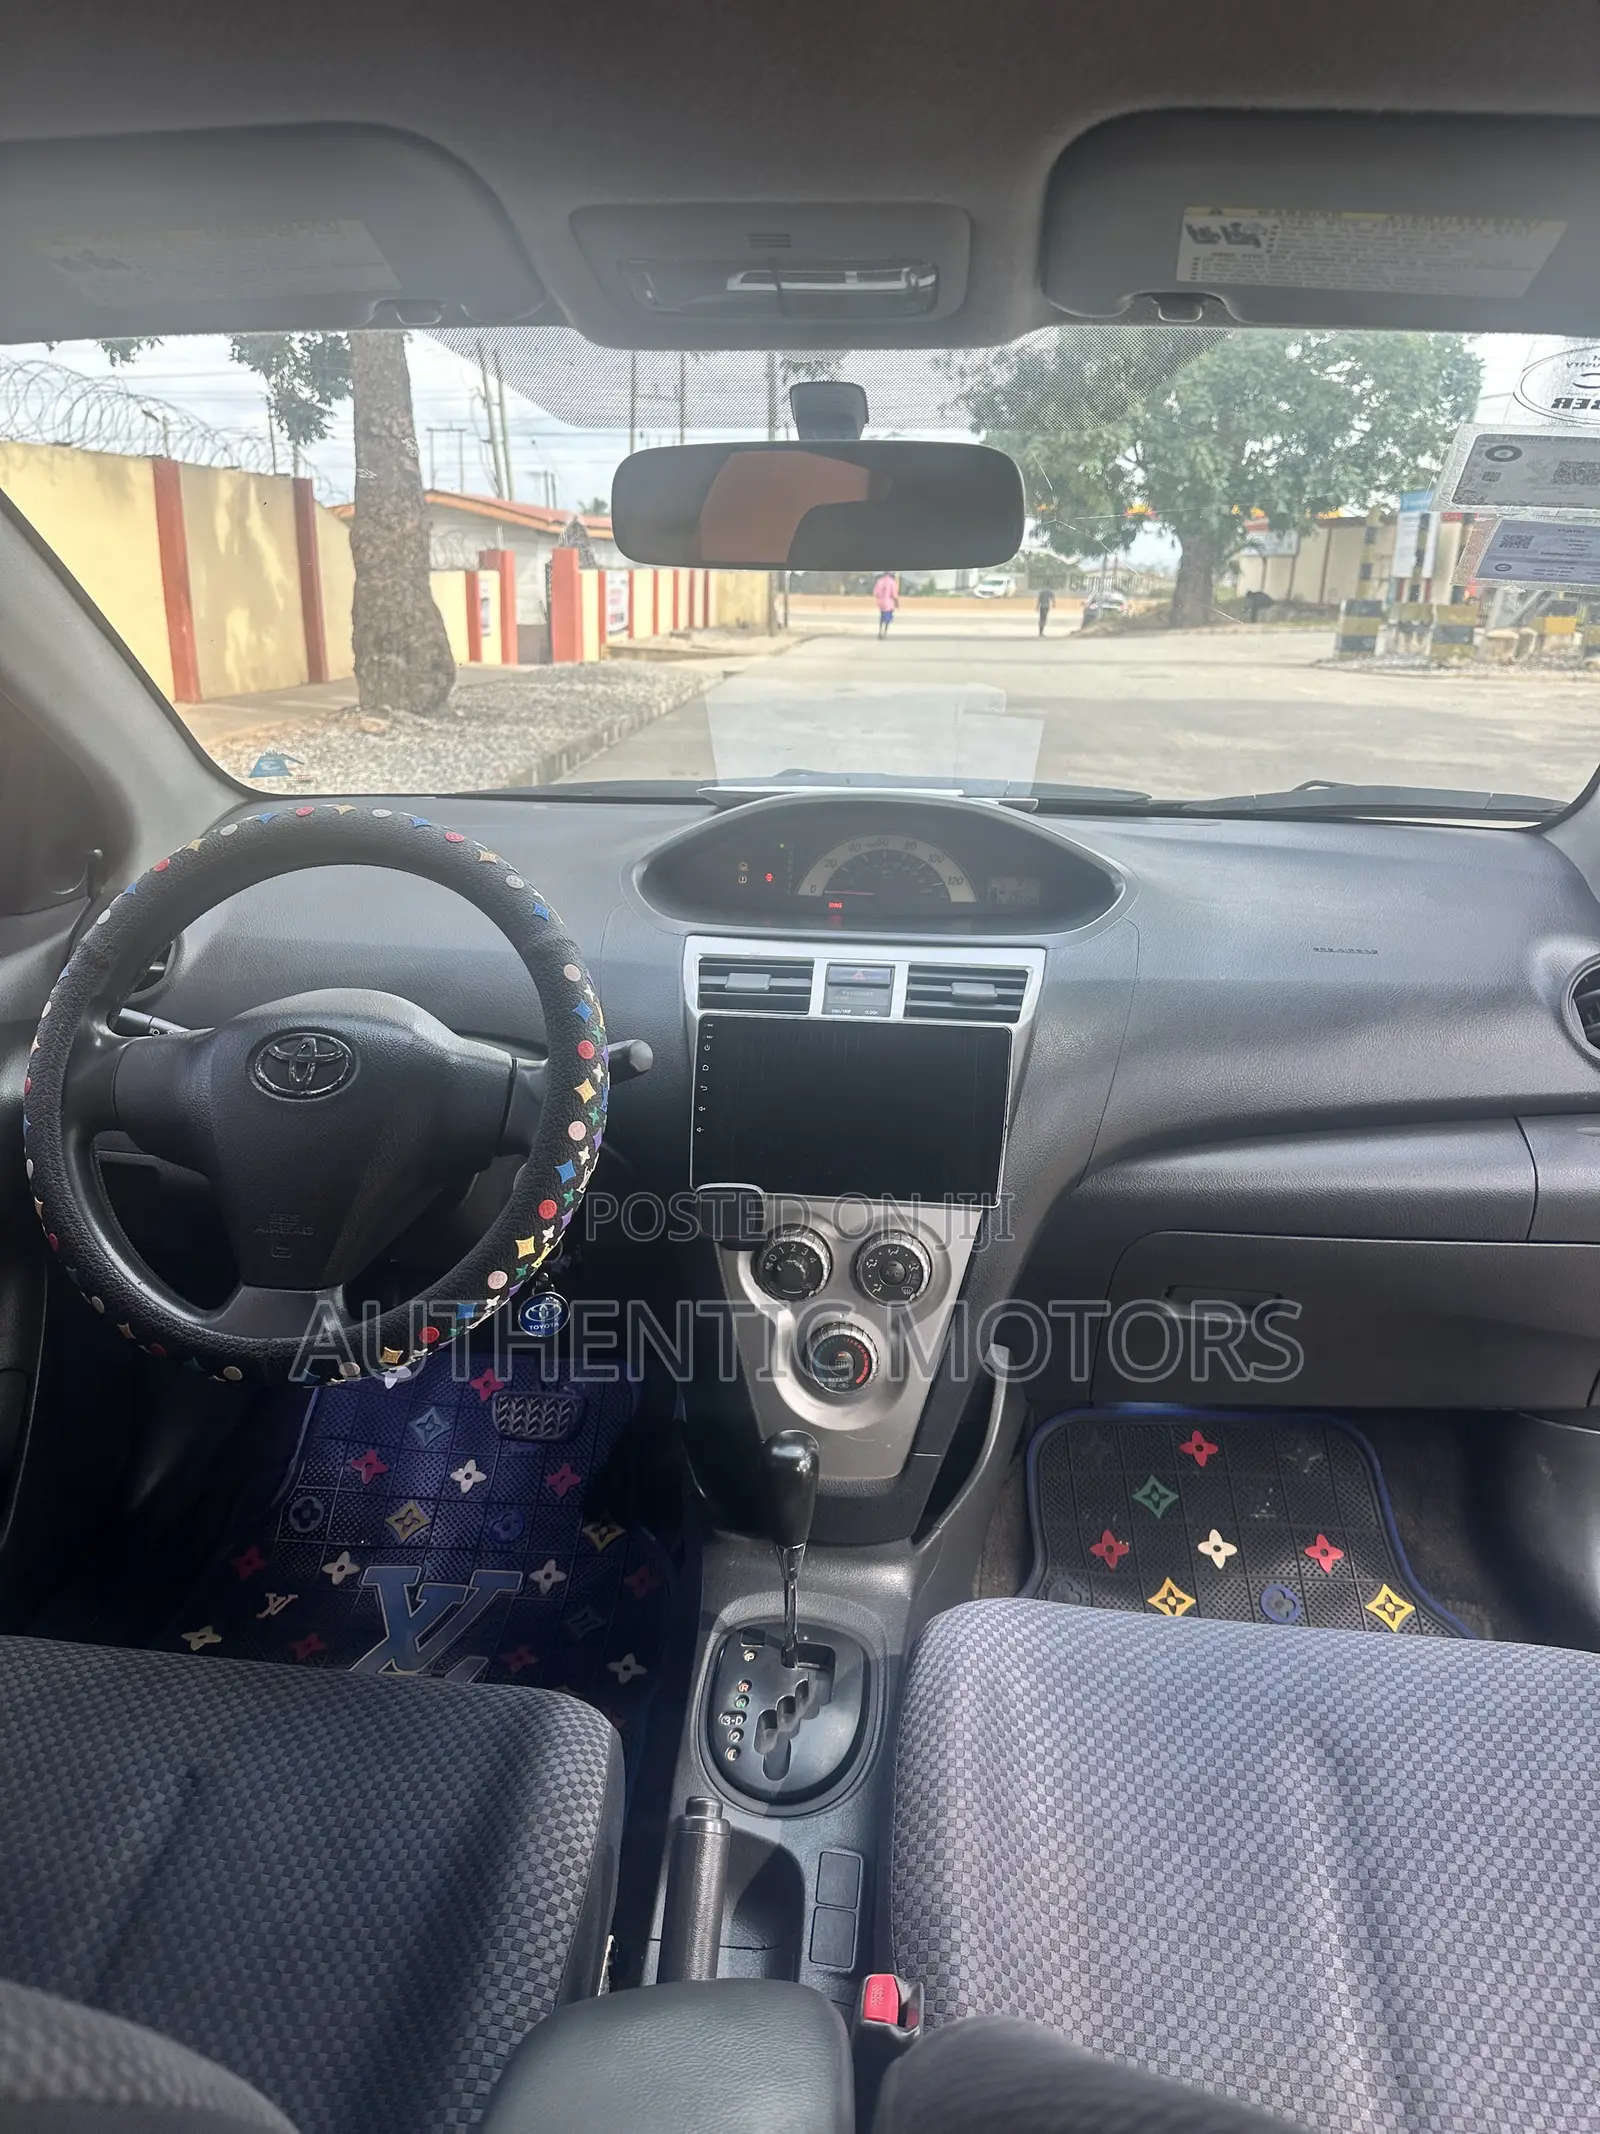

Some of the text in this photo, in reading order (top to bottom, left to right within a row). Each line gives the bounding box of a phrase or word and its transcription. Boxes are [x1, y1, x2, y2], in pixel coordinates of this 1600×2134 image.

[824, 859, 838, 868] 20
[928, 854, 944, 863] 100
[948, 876, 964, 886] 120
[779, 1246, 785, 1254] 1
[790, 1243, 797, 1252] 2
[801, 1247, 809, 1256] 3
[529, 1322, 560, 1331] TOYOTA
[721, 1715, 743, 1726] 3-D
[730, 1731, 740, 1742] 2
